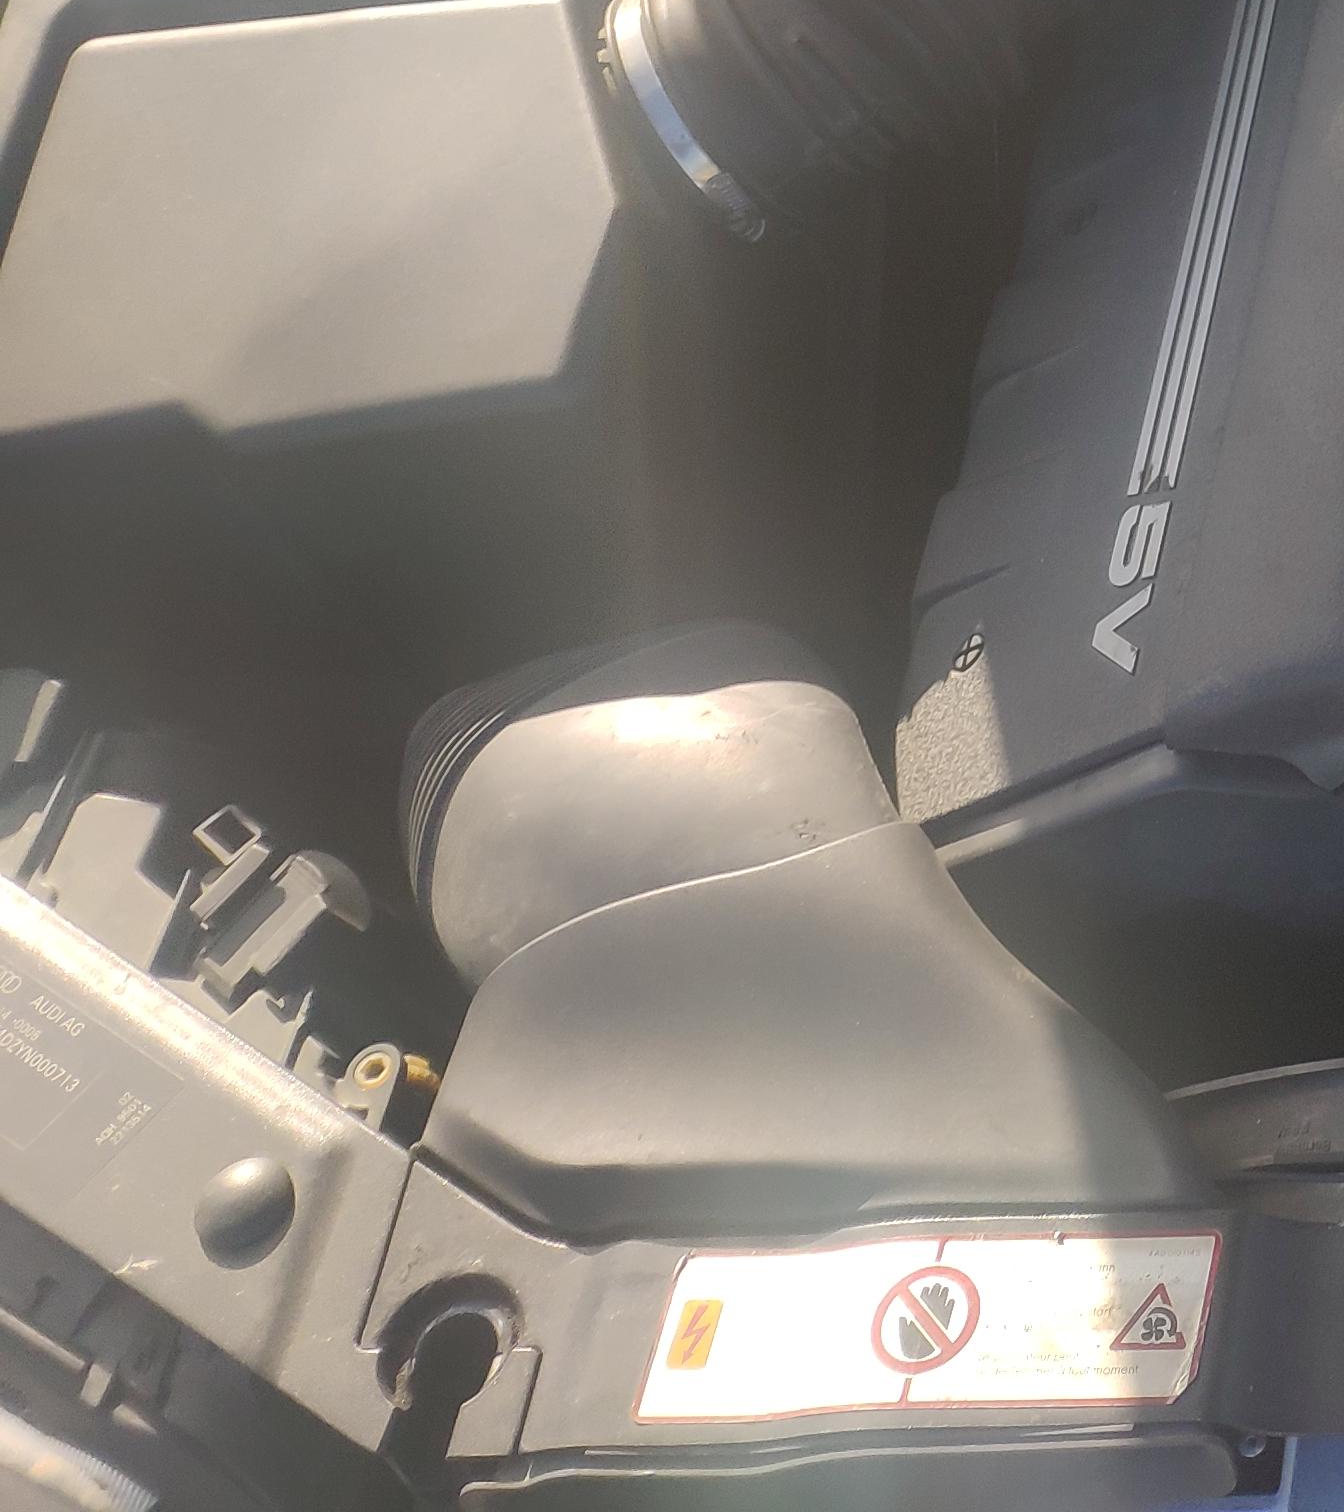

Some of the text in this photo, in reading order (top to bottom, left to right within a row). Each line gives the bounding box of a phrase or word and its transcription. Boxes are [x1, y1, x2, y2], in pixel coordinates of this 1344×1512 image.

[29, 995, 86, 1038] AUDI AG
[1093, 1364, 1140, 1376] moment
